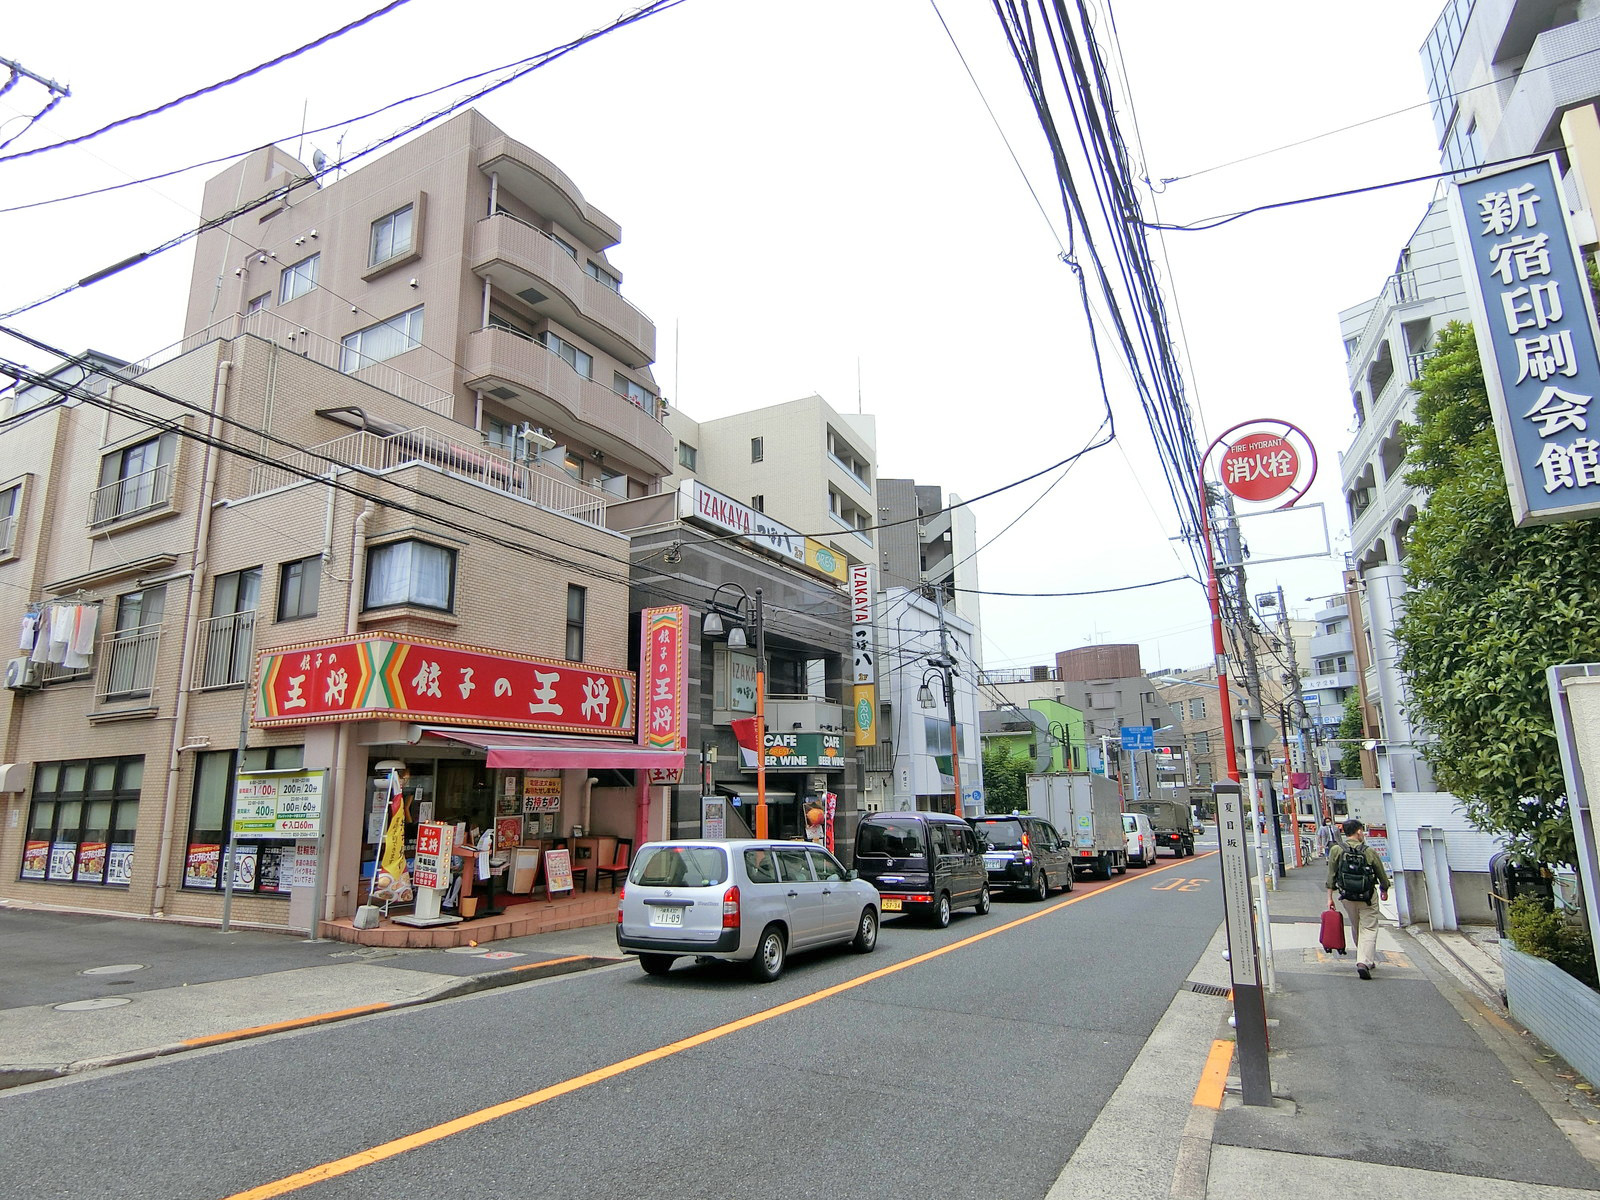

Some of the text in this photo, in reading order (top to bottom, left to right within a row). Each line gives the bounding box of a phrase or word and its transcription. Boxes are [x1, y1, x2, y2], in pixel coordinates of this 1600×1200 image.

[1476, 182, 1600, 494] 新宿印刷会館
[1231, 438, 1283, 454] FIRE HYDRANT
[1226, 449, 1294, 484] 消火栓
[699, 489, 750, 534] IZAKAYA
[853, 567, 869, 622] IZAKAYA
[855, 629, 873, 667] つぼ八
[300, 653, 337, 671] 餃子の
[652, 629, 674, 732] 餃子の王将
[732, 662, 766, 684] IZAKA
[284, 667, 349, 711] 王将
[412, 659, 611, 723] 餃子の王将
[858, 690, 871, 741] FORESTA
[764, 735, 797, 747] CAFE
[823, 735, 840, 748] CAFE
[780, 756, 808, 766] WINE
[818, 756, 845, 766] BEER WINE
[652, 767, 679, 781] 王将
[525, 796, 559, 807] お持ち帰り
[288, 820, 314, 829] 入口60m
[419, 837, 439, 853] 王将
